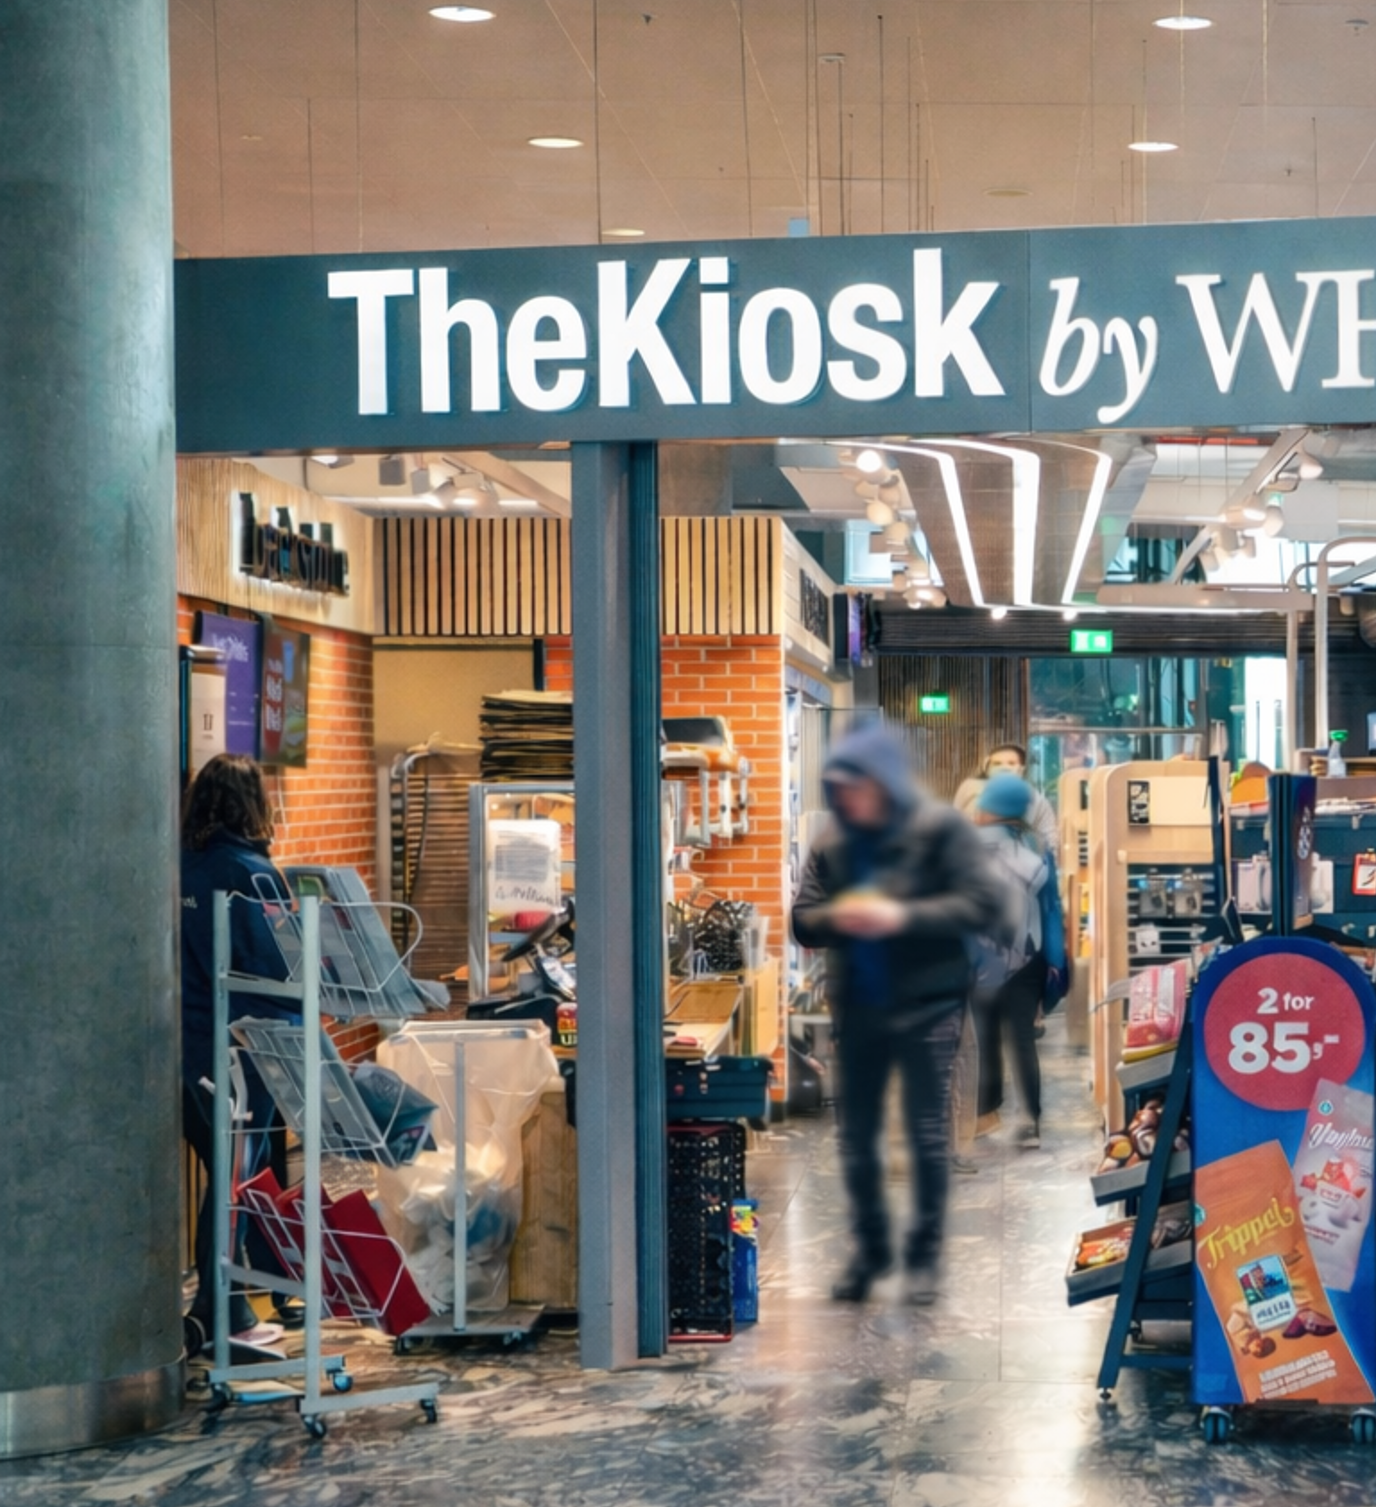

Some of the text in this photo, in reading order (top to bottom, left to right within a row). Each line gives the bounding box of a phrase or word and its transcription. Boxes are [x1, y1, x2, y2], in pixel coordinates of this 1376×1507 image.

[327, 247, 1006, 416] TheKiosk
[1039, 276, 1159, 424] by
[1256, 986, 1279, 1014] 2
[1228, 1021, 1340, 1075] 85,-
